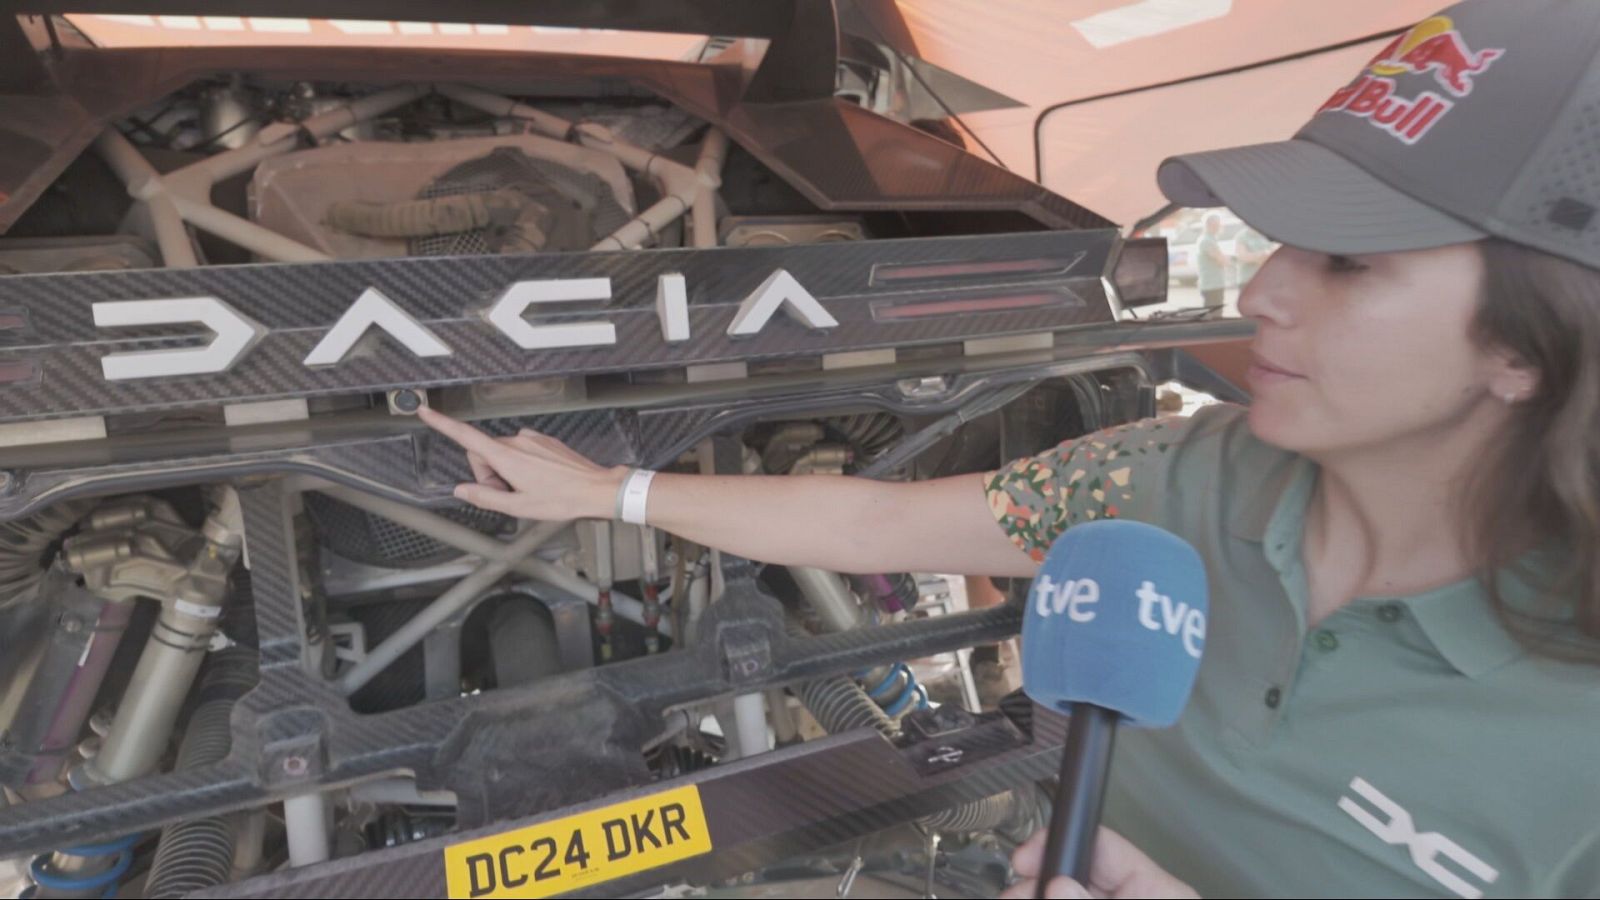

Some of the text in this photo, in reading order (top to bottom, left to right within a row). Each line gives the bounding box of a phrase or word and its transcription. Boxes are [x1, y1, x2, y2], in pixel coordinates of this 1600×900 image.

[1344, 76, 1453, 143] Bull
[92, 269, 839, 379] DACIA
[1036, 575, 1099, 621] tve
[1136, 581, 1206, 658] tve
[466, 803, 690, 898] DC24 DKR
